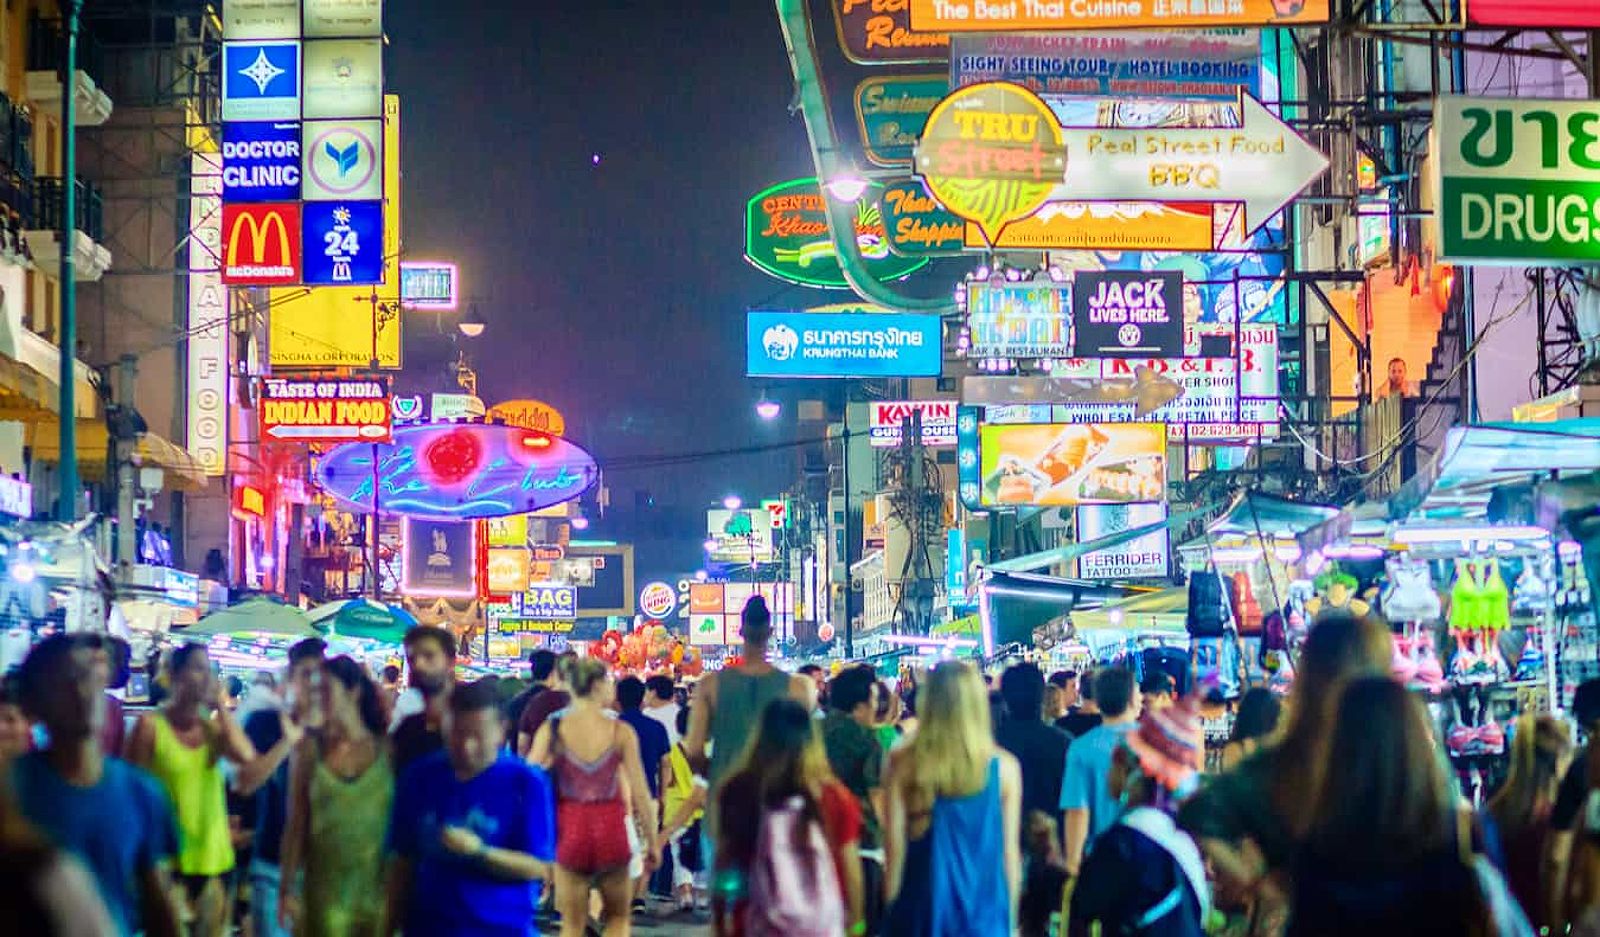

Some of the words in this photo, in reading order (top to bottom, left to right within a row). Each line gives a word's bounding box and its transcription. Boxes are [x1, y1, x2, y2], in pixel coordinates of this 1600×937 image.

[936, 0, 968, 18] The
[974, 0, 1016, 18] Best
[1025, 0, 1064, 18] Thai
[1071, 0, 1141, 17] Cuisine
[961, 56, 1004, 70] SIGHT
[1011, 57, 1062, 71] SEEING
[1068, 58, 1108, 73] TOUR
[1129, 59, 1173, 74] HOTEL
[1180, 61, 1249, 76] BOOKING
[953, 110, 1037, 141] TRU
[223, 140, 300, 159] DOCTOR
[1087, 134, 1137, 155] Real
[1144, 135, 1220, 154] Street
[1229, 135, 1284, 154] Food
[938, 139, 1046, 183] Street
[223, 165, 300, 187] CLINIC
[1149, 163, 1220, 188] BBQ
[324, 230, 360, 256] 24
[1088, 278, 1166, 308] JACK
[1089, 307, 1128, 323] LIVES
[1129, 307, 1170, 323] HERE.
[802, 327, 923, 350] ธนาคารกรุงไทย
[272, 353, 312, 361] SINGHA
[803, 348, 867, 359] KRUNGTHAI
[868, 348, 898, 358] BANK
[268, 382, 316, 398] TASTE
[317, 383, 337, 398] OF
[338, 383, 383, 398] INDIA
[196, 357, 220, 470] FOOD
[264, 401, 332, 424] INDIAN
[335, 401, 385, 424] FOOD
[878, 403, 949, 424] KAWIN
[1086, 553, 1161, 566] FERRIDER
[1088, 568, 1130, 577] TATTOO
[524, 589, 572, 606] BAG
[647, 597, 671, 609] KING
